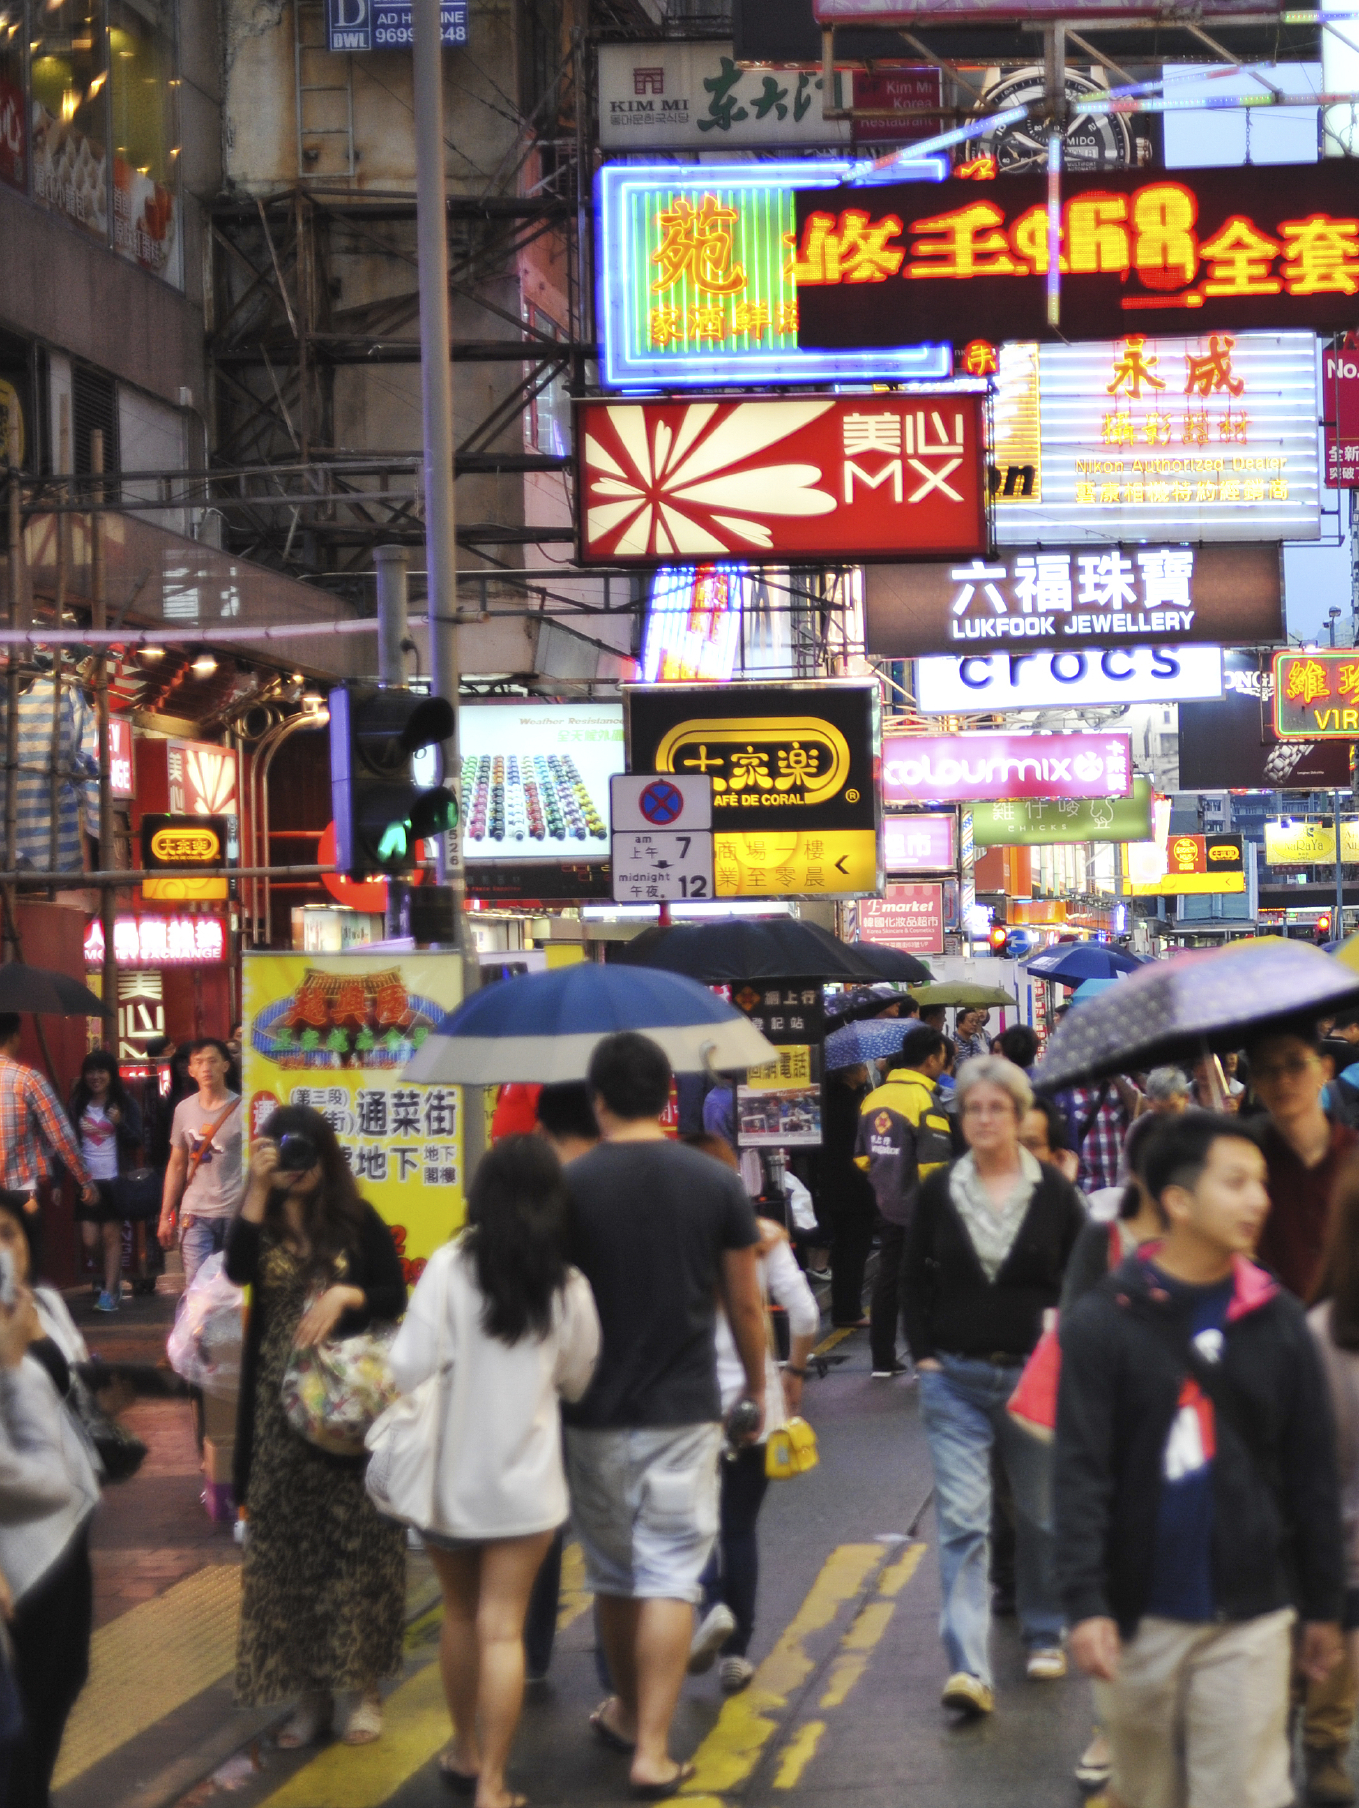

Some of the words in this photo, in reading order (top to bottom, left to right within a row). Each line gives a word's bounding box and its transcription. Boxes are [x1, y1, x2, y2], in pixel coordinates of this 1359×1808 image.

[376, 13, 398, 25] AD
[333, 32, 367, 48] DWL
[887, 81, 912, 94] Kim
[916, 81, 932, 93] Mi
[610, 100, 655, 112] KIM
[661, 99, 690, 111] MI
[1067, 136, 1096, 146] MIDO
[843, 411, 964, 456] 美心
[1074, 457, 1125, 473] Nikon
[1131, 456, 1227, 474] Authorized
[843, 457, 965, 504] MX
[950, 549, 1196, 616] 六福珠寶
[951, 614, 1056, 639] LUKFOOK
[1063, 610, 1195, 636] JEWELLERY
[957, 648, 1181, 690] crocs
[519, 717, 565, 726] Weather
[883, 752, 1073, 787] colourmix
[741, 793, 758, 806] DE
[760, 792, 806, 806] CORAL
[634, 834, 653, 844] am
[675, 836, 692, 860] 7
[629, 846, 659, 860] 上午
[618, 872, 671, 883] midnight
[677, 874, 708, 898] 12
[867, 898, 934, 916] Emarket
[355, 1088, 459, 1138] 通菜街
